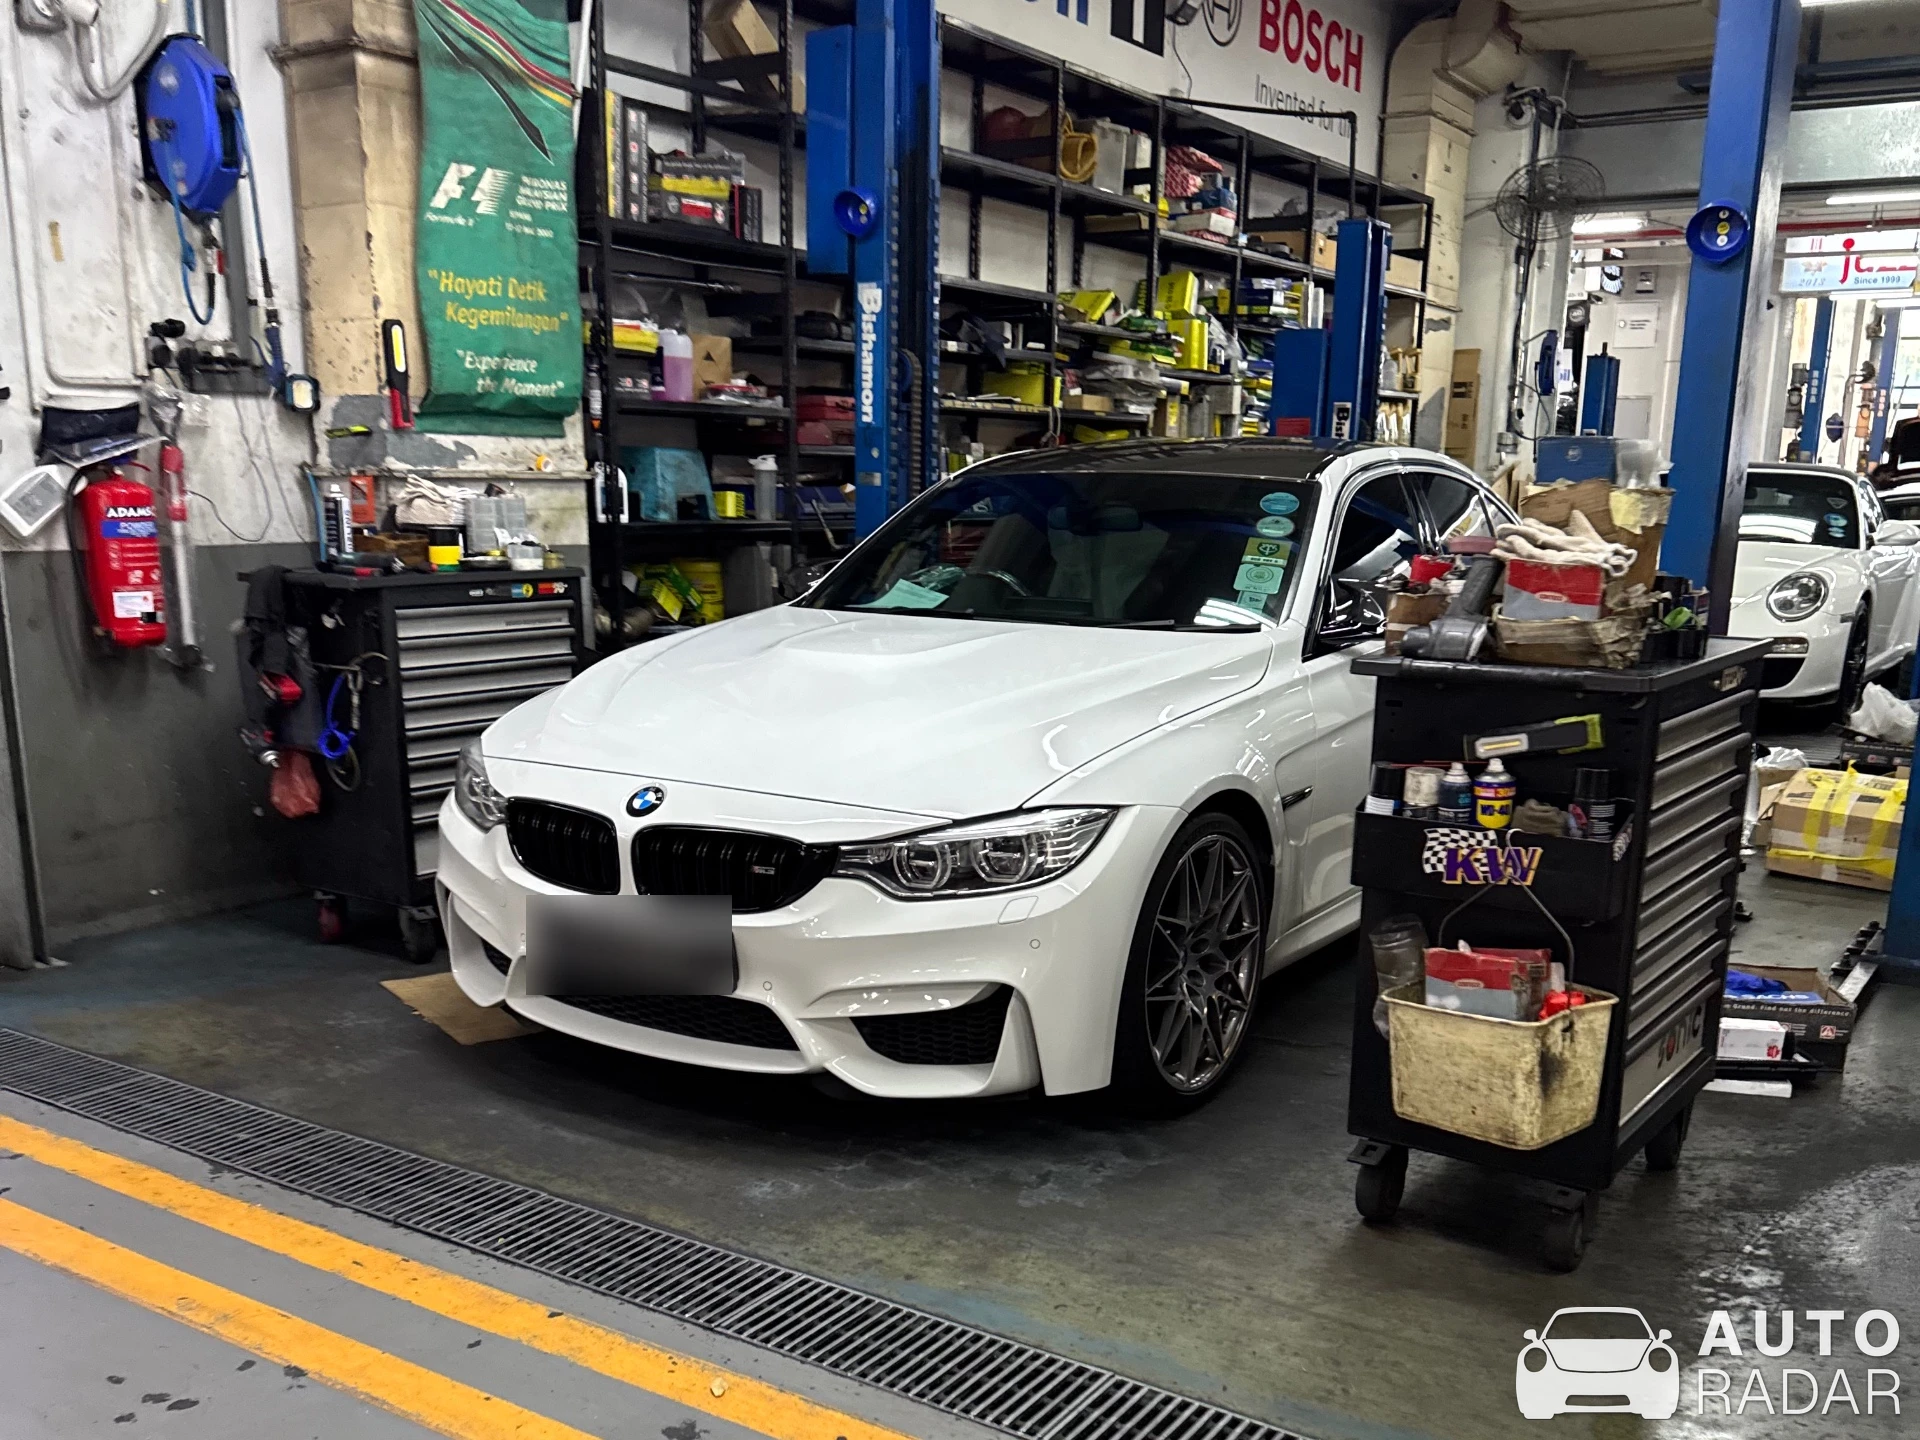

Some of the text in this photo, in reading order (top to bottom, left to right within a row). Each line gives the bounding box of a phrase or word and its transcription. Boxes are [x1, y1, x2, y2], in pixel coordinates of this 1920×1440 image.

[1259, 0, 1363, 93] BOSCH
[1255, 74, 1315, 124] Invented
[508, 277, 547, 301] Detik
[1854, 277, 1878, 285] Since
[1881, 276, 1901, 284] 1999
[857, 282, 883, 423] Bishamon
[1442, 847, 1543, 885] KW
